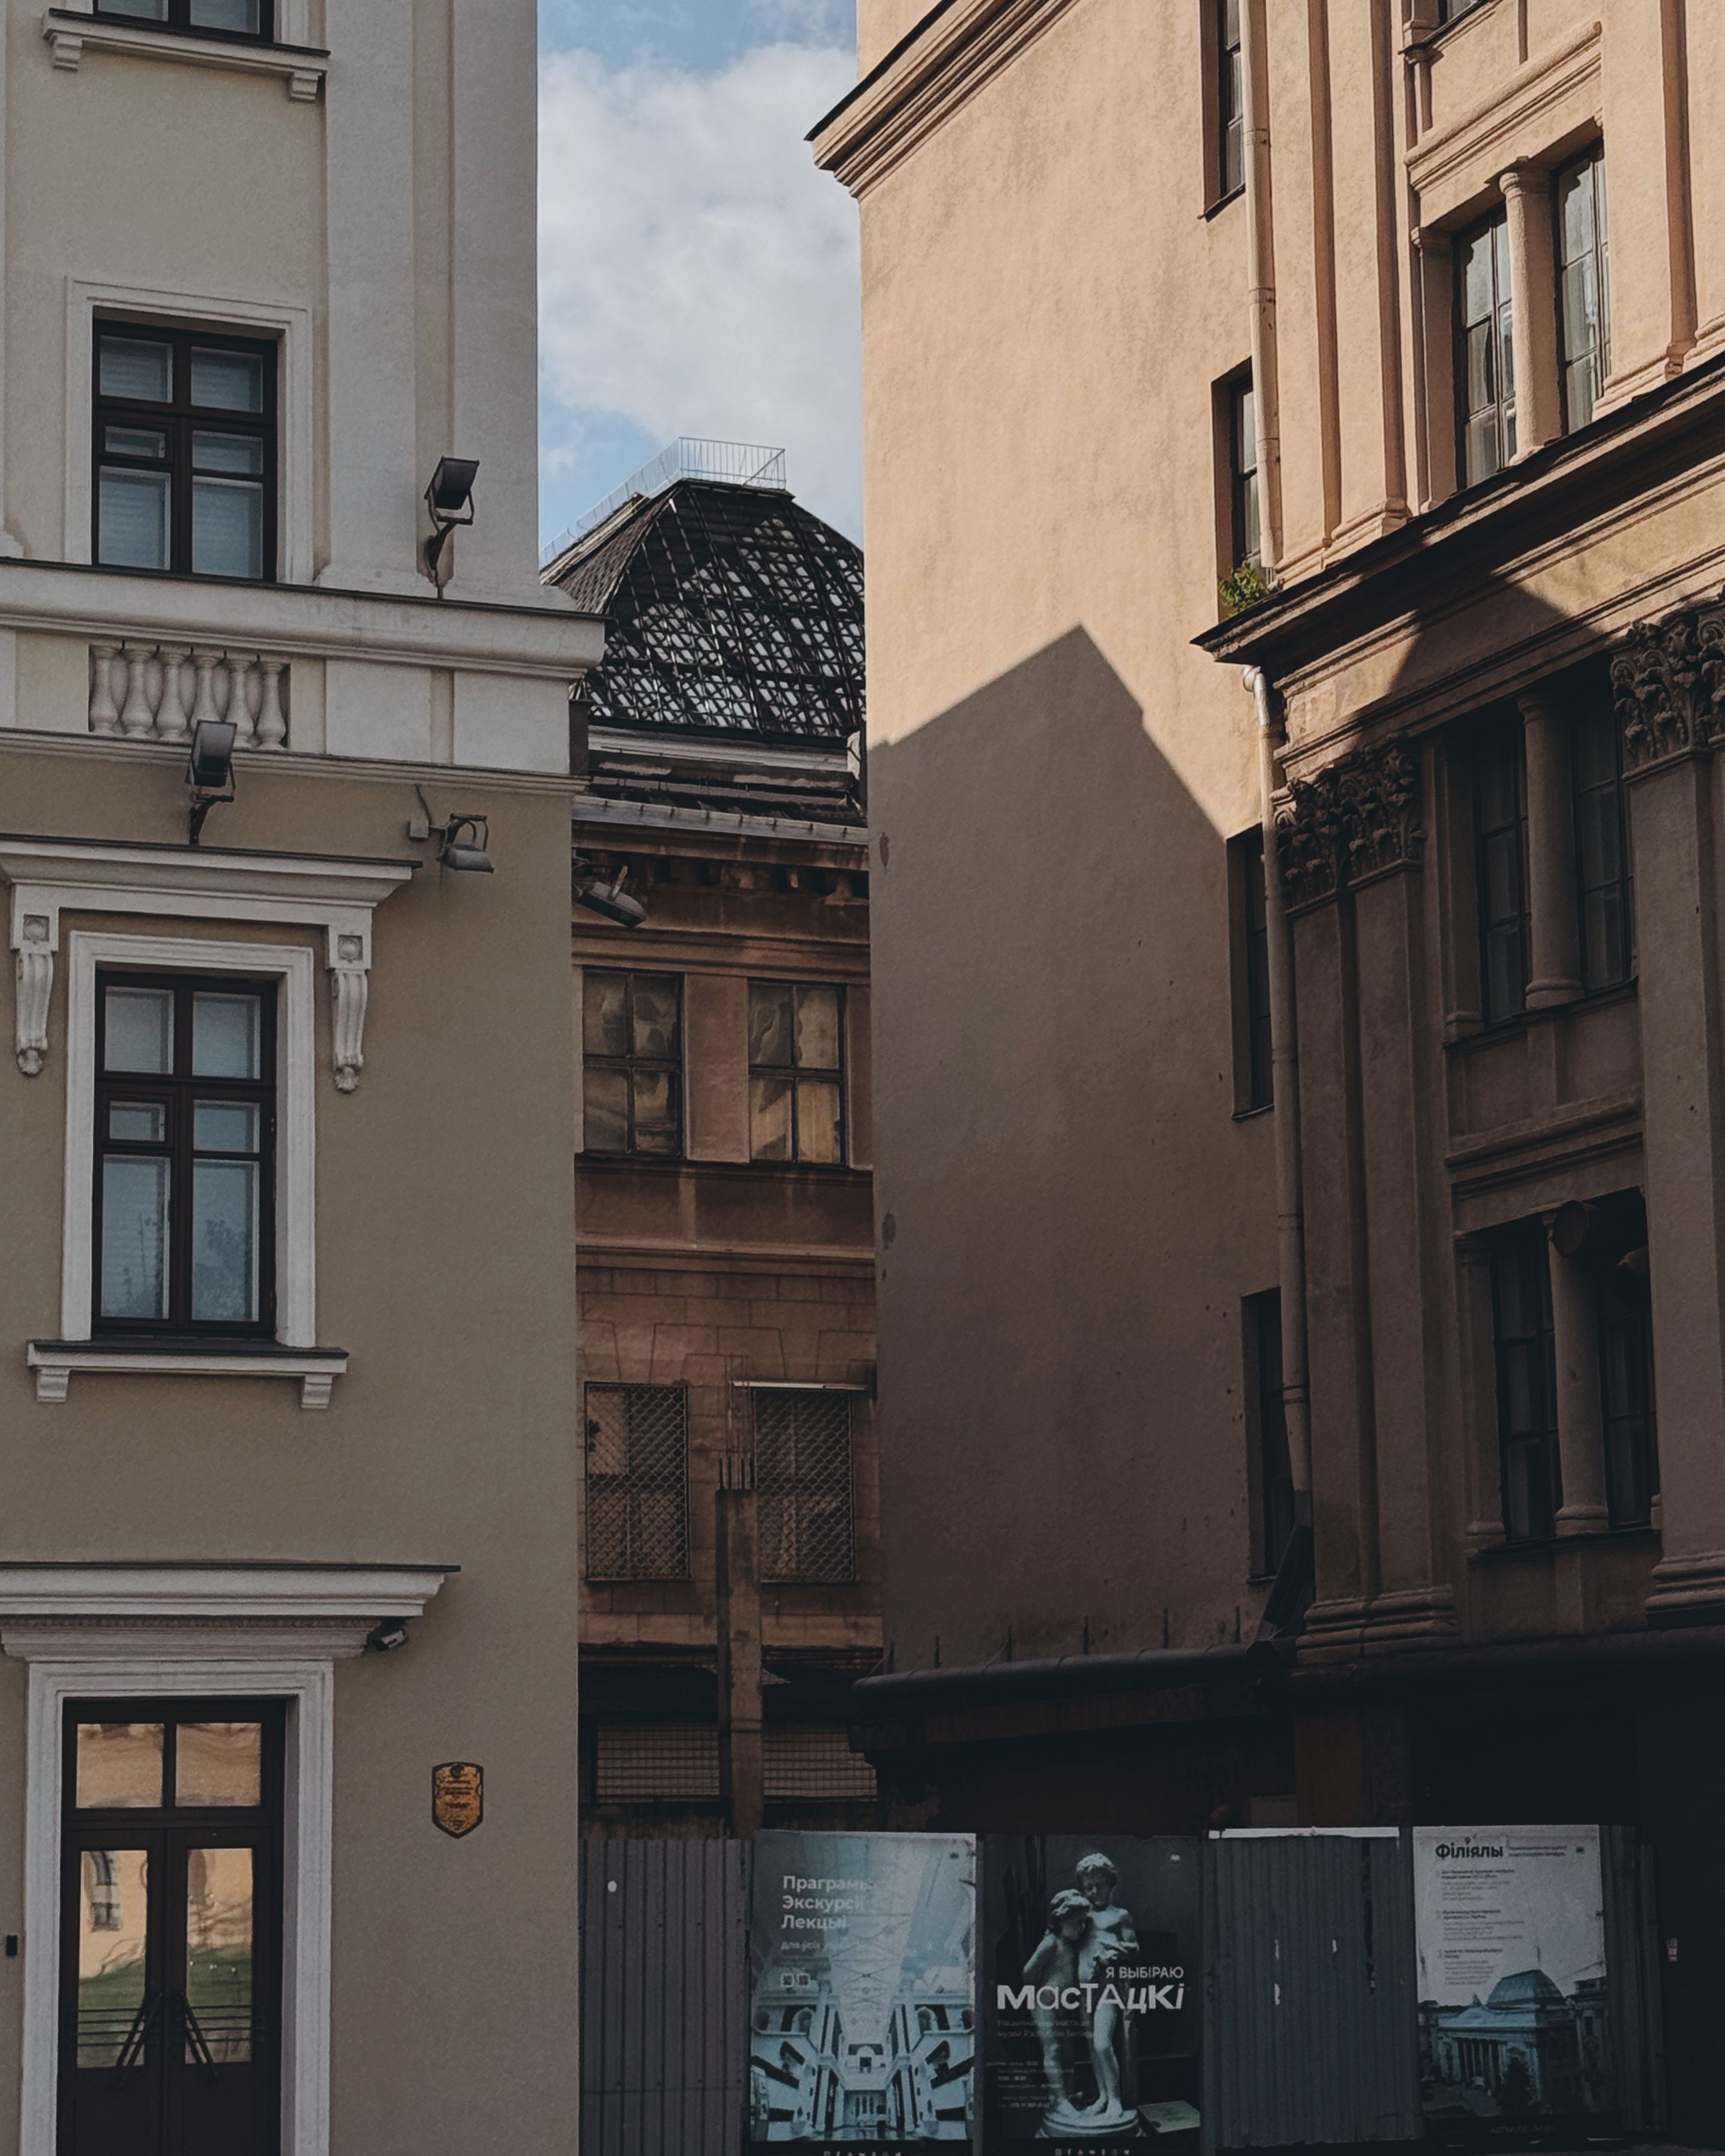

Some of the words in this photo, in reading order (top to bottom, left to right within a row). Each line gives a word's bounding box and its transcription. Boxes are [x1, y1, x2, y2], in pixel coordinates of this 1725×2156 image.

[1435, 1837, 1504, 1858] Філіялы
[781, 1914, 847, 1932] Лекцыі
[1105, 1966, 1114, 1979] Я
[1119, 1966, 1184, 1979] ВЫБІРАЮ
